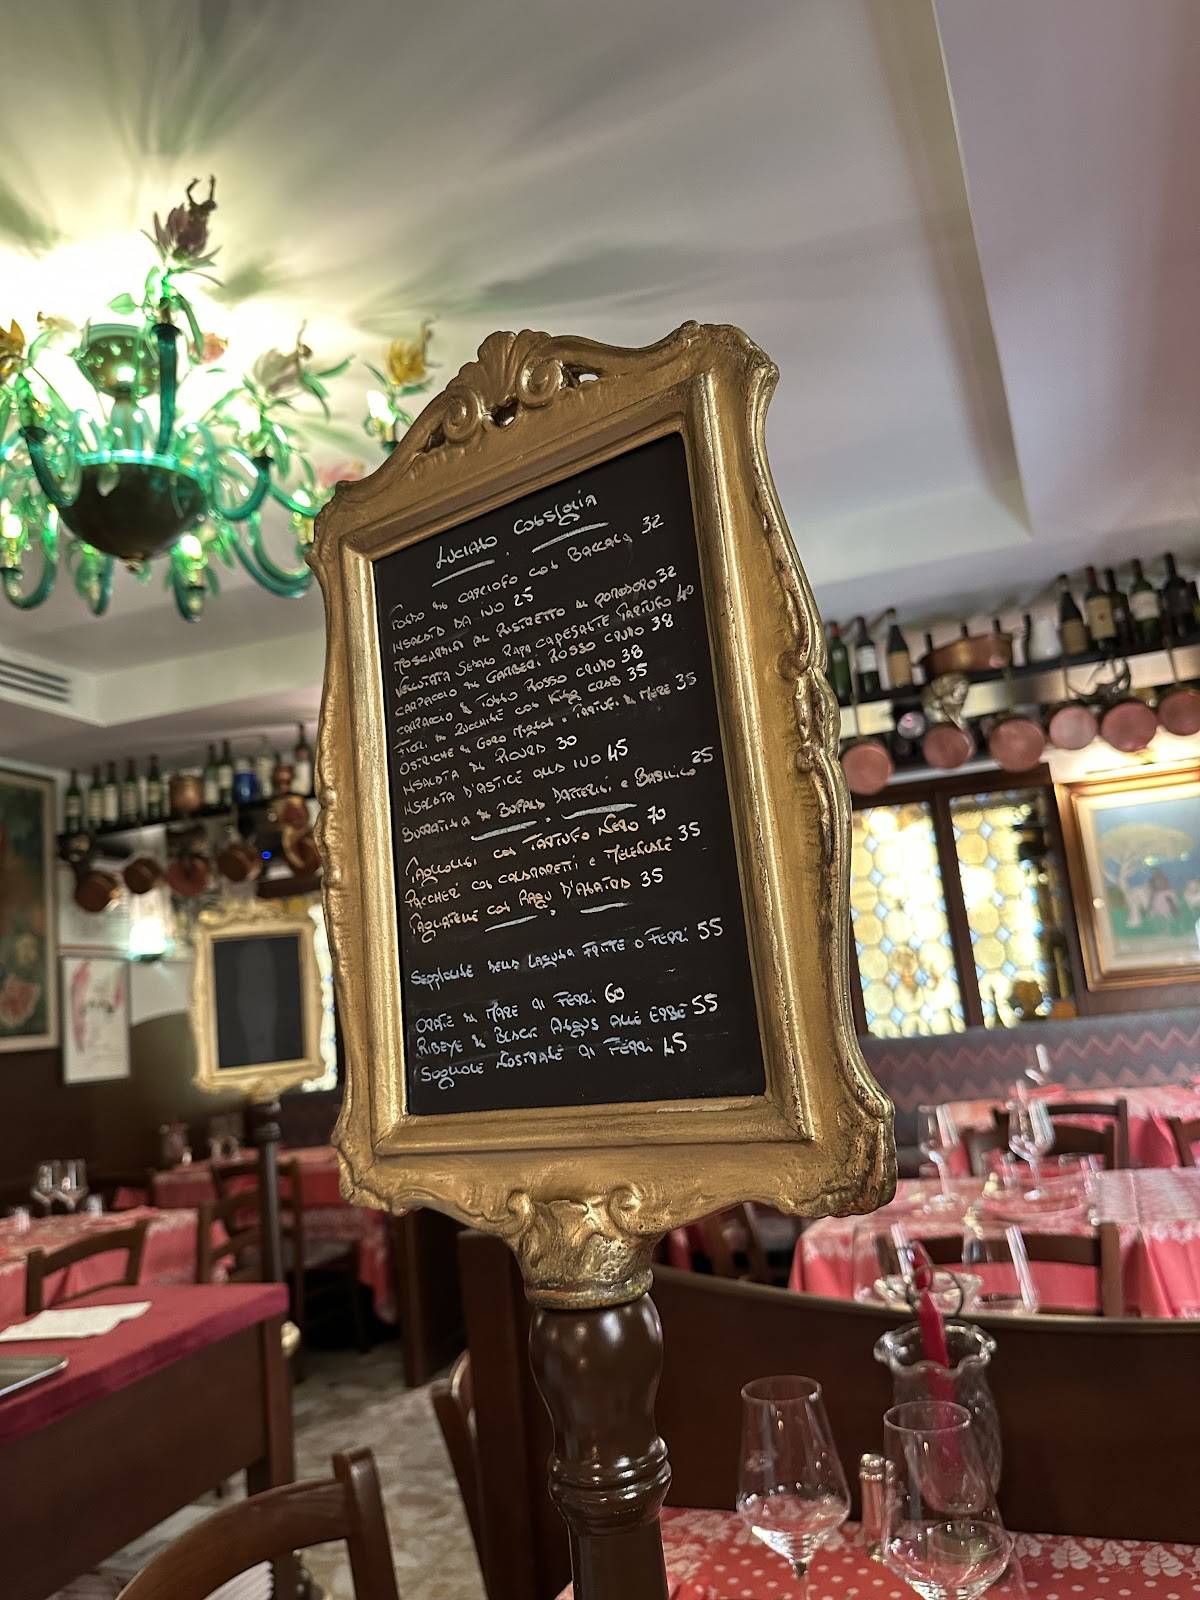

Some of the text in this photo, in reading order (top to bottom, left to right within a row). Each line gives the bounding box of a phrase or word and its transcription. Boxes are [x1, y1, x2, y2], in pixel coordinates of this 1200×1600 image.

[641, 513, 665, 535] 32
[655, 565, 677, 584] 32
[676, 583, 694, 602] 40
[453, 615, 472, 630] DA
[513, 585, 534, 607] 25
[548, 641, 597, 664] ROSSO
[651, 612, 674, 632] 38
[523, 674, 568, 693] ROSSO
[621, 644, 644, 664] 38
[626, 662, 648, 682] 35
[675, 671, 697, 691] 35
[555, 735, 578, 751] 30
[607, 738, 629, 762] 45
[691, 746, 714, 764] 25
[647, 805, 667, 825] 70
[677, 821, 701, 842] 35
[640, 867, 664, 888] 35
[697, 917, 724, 941] 55
[604, 982, 625, 1004] 60
[691, 992, 718, 1015] 55
